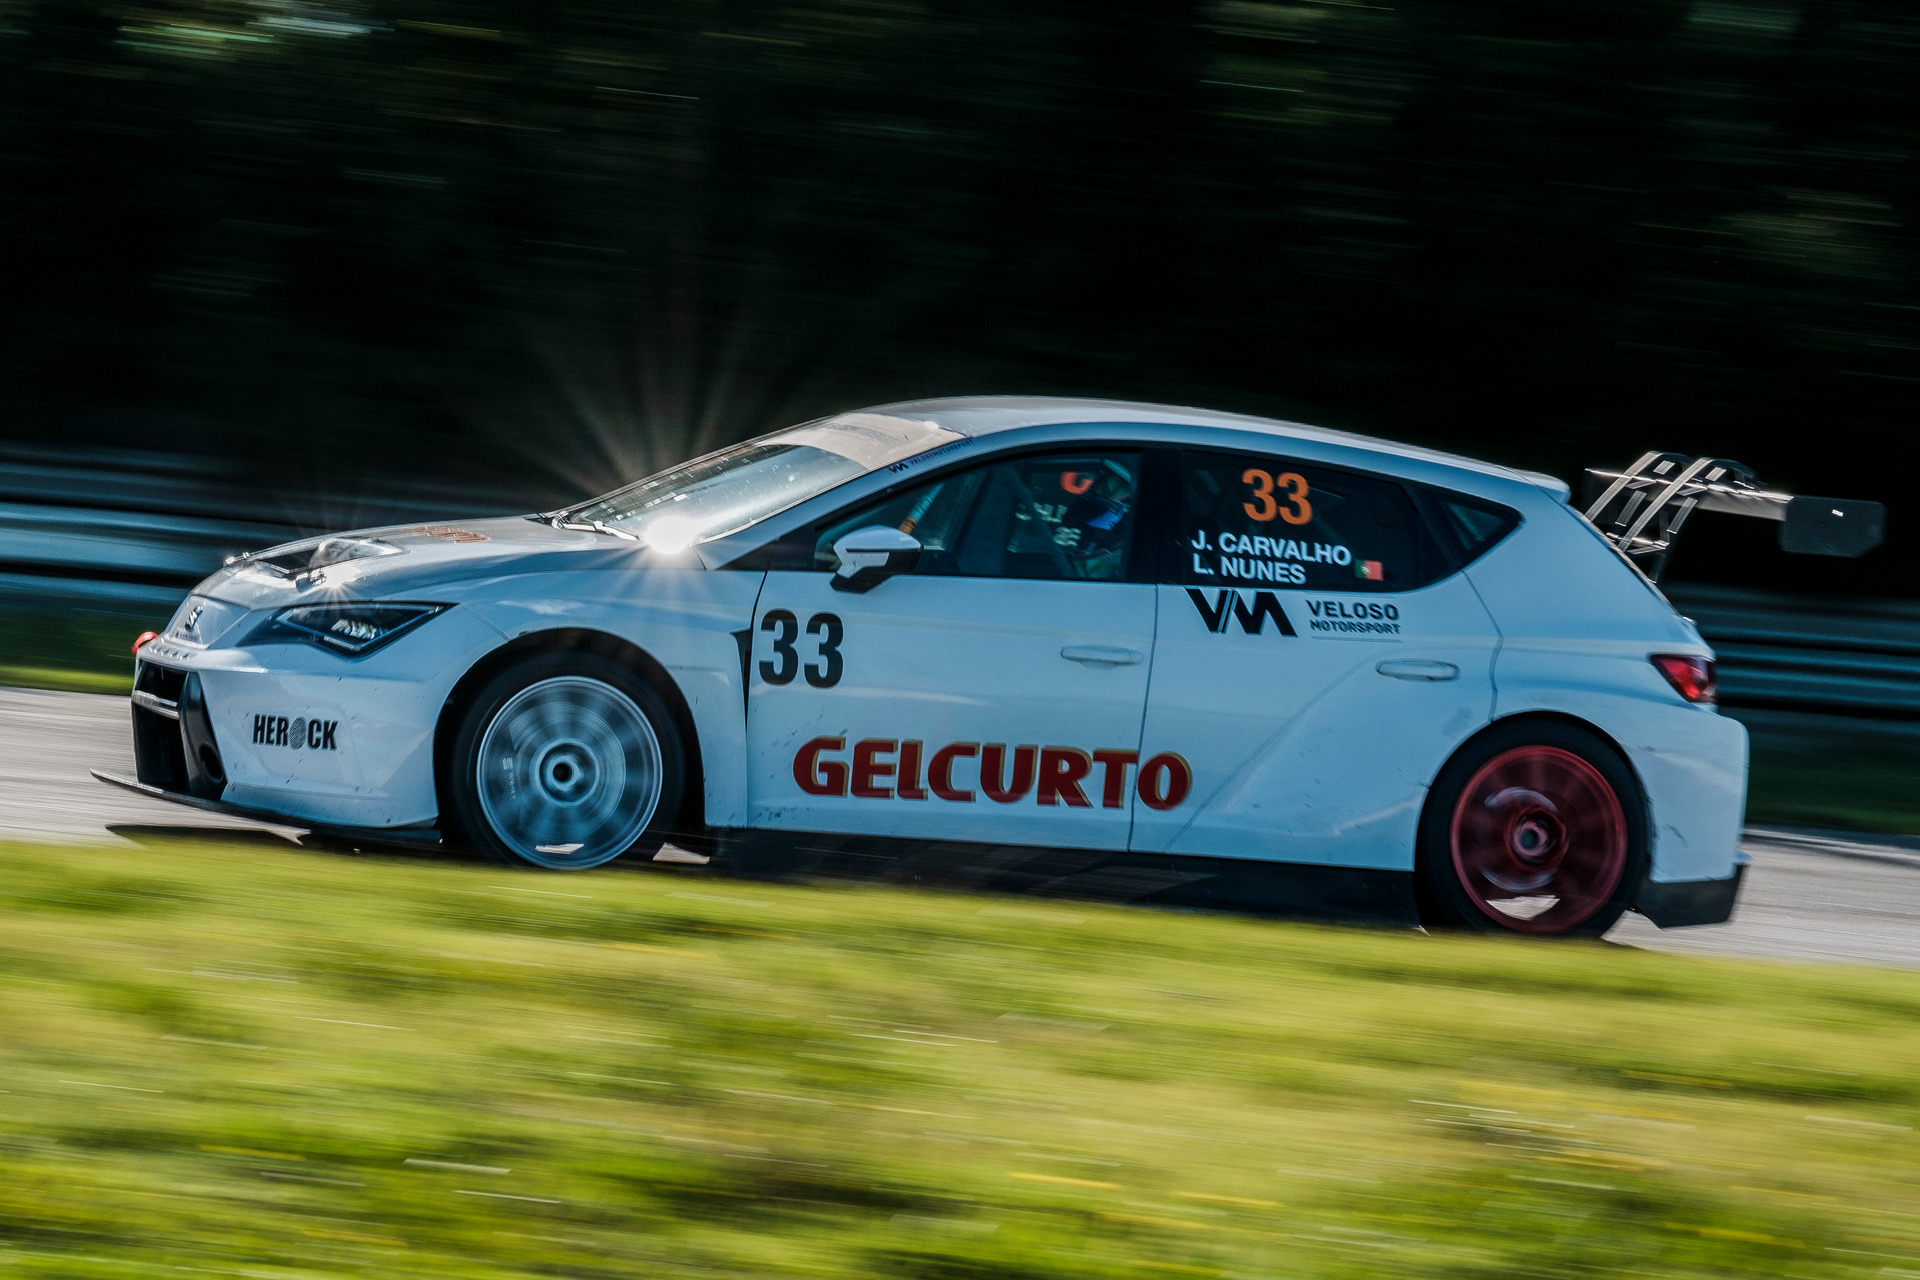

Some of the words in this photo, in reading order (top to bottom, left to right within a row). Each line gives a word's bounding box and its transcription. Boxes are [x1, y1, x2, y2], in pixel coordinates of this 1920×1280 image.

[1242, 468, 1313, 526] 33
[1191, 529, 1214, 551] J.
[1218, 532, 1352, 567] CARVALHO
[1192, 553, 1215, 575] L.
[1220, 556, 1307, 585] NUNES
[1305, 599, 1400, 621] VELOSO
[1309, 619, 1402, 635] MOTORSPORT
[758, 608, 844, 688] 33
[793, 735, 1193, 811] GELCURTO
